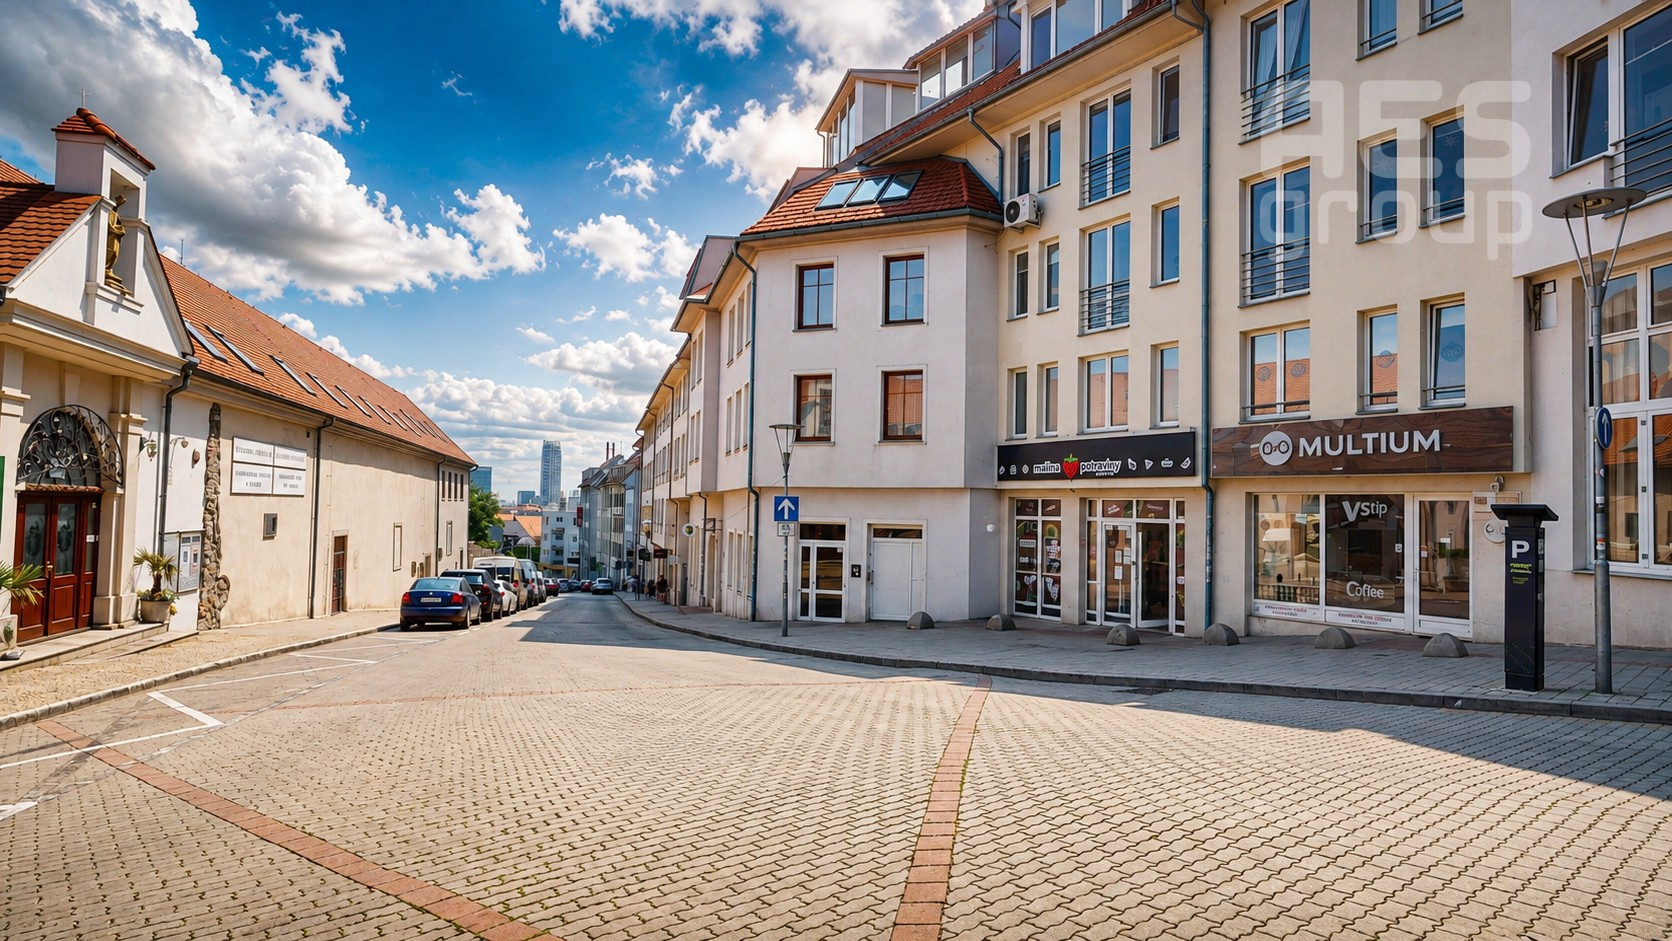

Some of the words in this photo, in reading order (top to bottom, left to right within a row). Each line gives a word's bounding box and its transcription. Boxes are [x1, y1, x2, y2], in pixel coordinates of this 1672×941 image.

[1298, 429, 1441, 457] MULTIUM
[1033, 461, 1060, 474] malina
[1080, 457, 1121, 475] potraviny
[1511, 540, 1530, 559] P
[1346, 581, 1384, 599] Coffee
